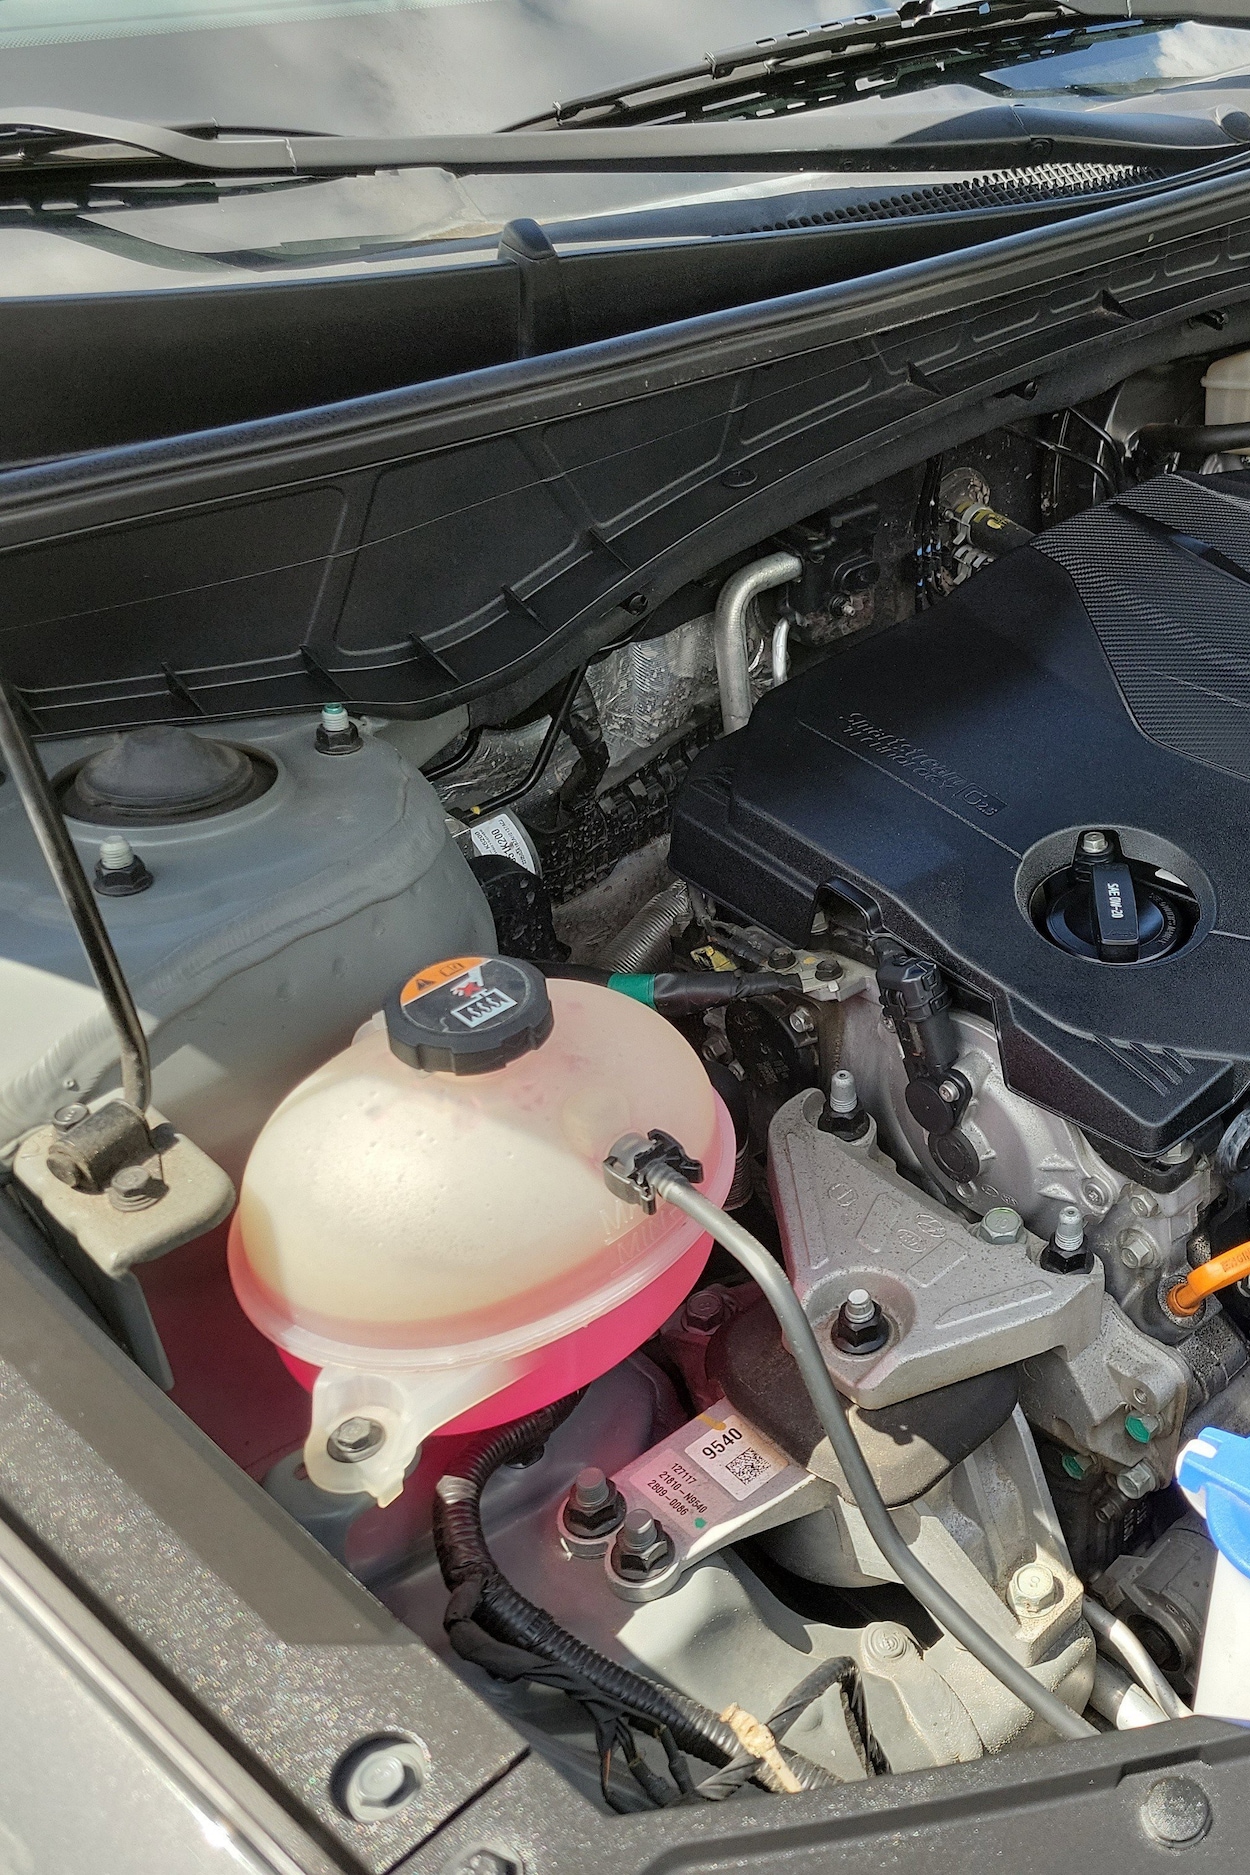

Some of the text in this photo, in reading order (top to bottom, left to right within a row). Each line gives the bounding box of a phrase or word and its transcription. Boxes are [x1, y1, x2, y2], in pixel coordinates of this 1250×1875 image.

[1107, 883, 1120, 896] SAE
[1109, 897, 1124, 919] 0W-20
[702, 1427, 743, 1460] 9540
[671, 1462, 697, 1485] 127117
[647, 1479, 689, 1516] 2B09-0086
